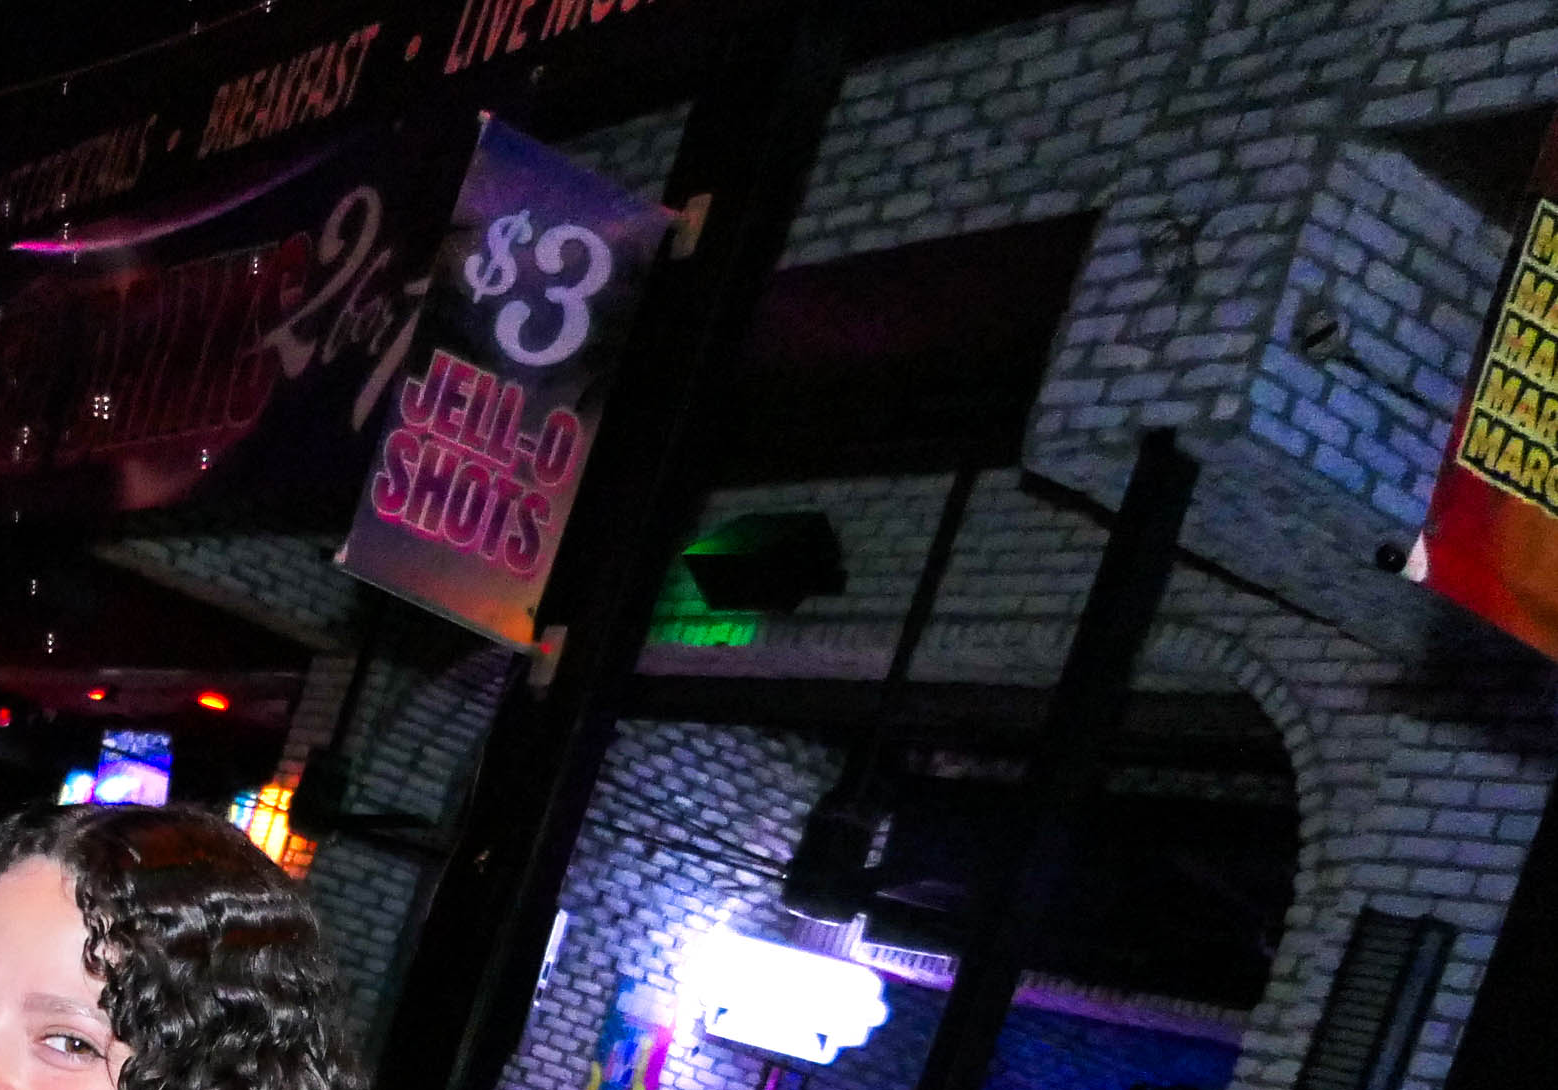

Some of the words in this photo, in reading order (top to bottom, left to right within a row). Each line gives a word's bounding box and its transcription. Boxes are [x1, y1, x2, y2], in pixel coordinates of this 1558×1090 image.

[197, 22, 382, 160] BREAKFAST
[464, 209, 613, 367] $3
[400, 349, 581, 487] JELL-O
[371, 430, 552, 576] SHOTS
